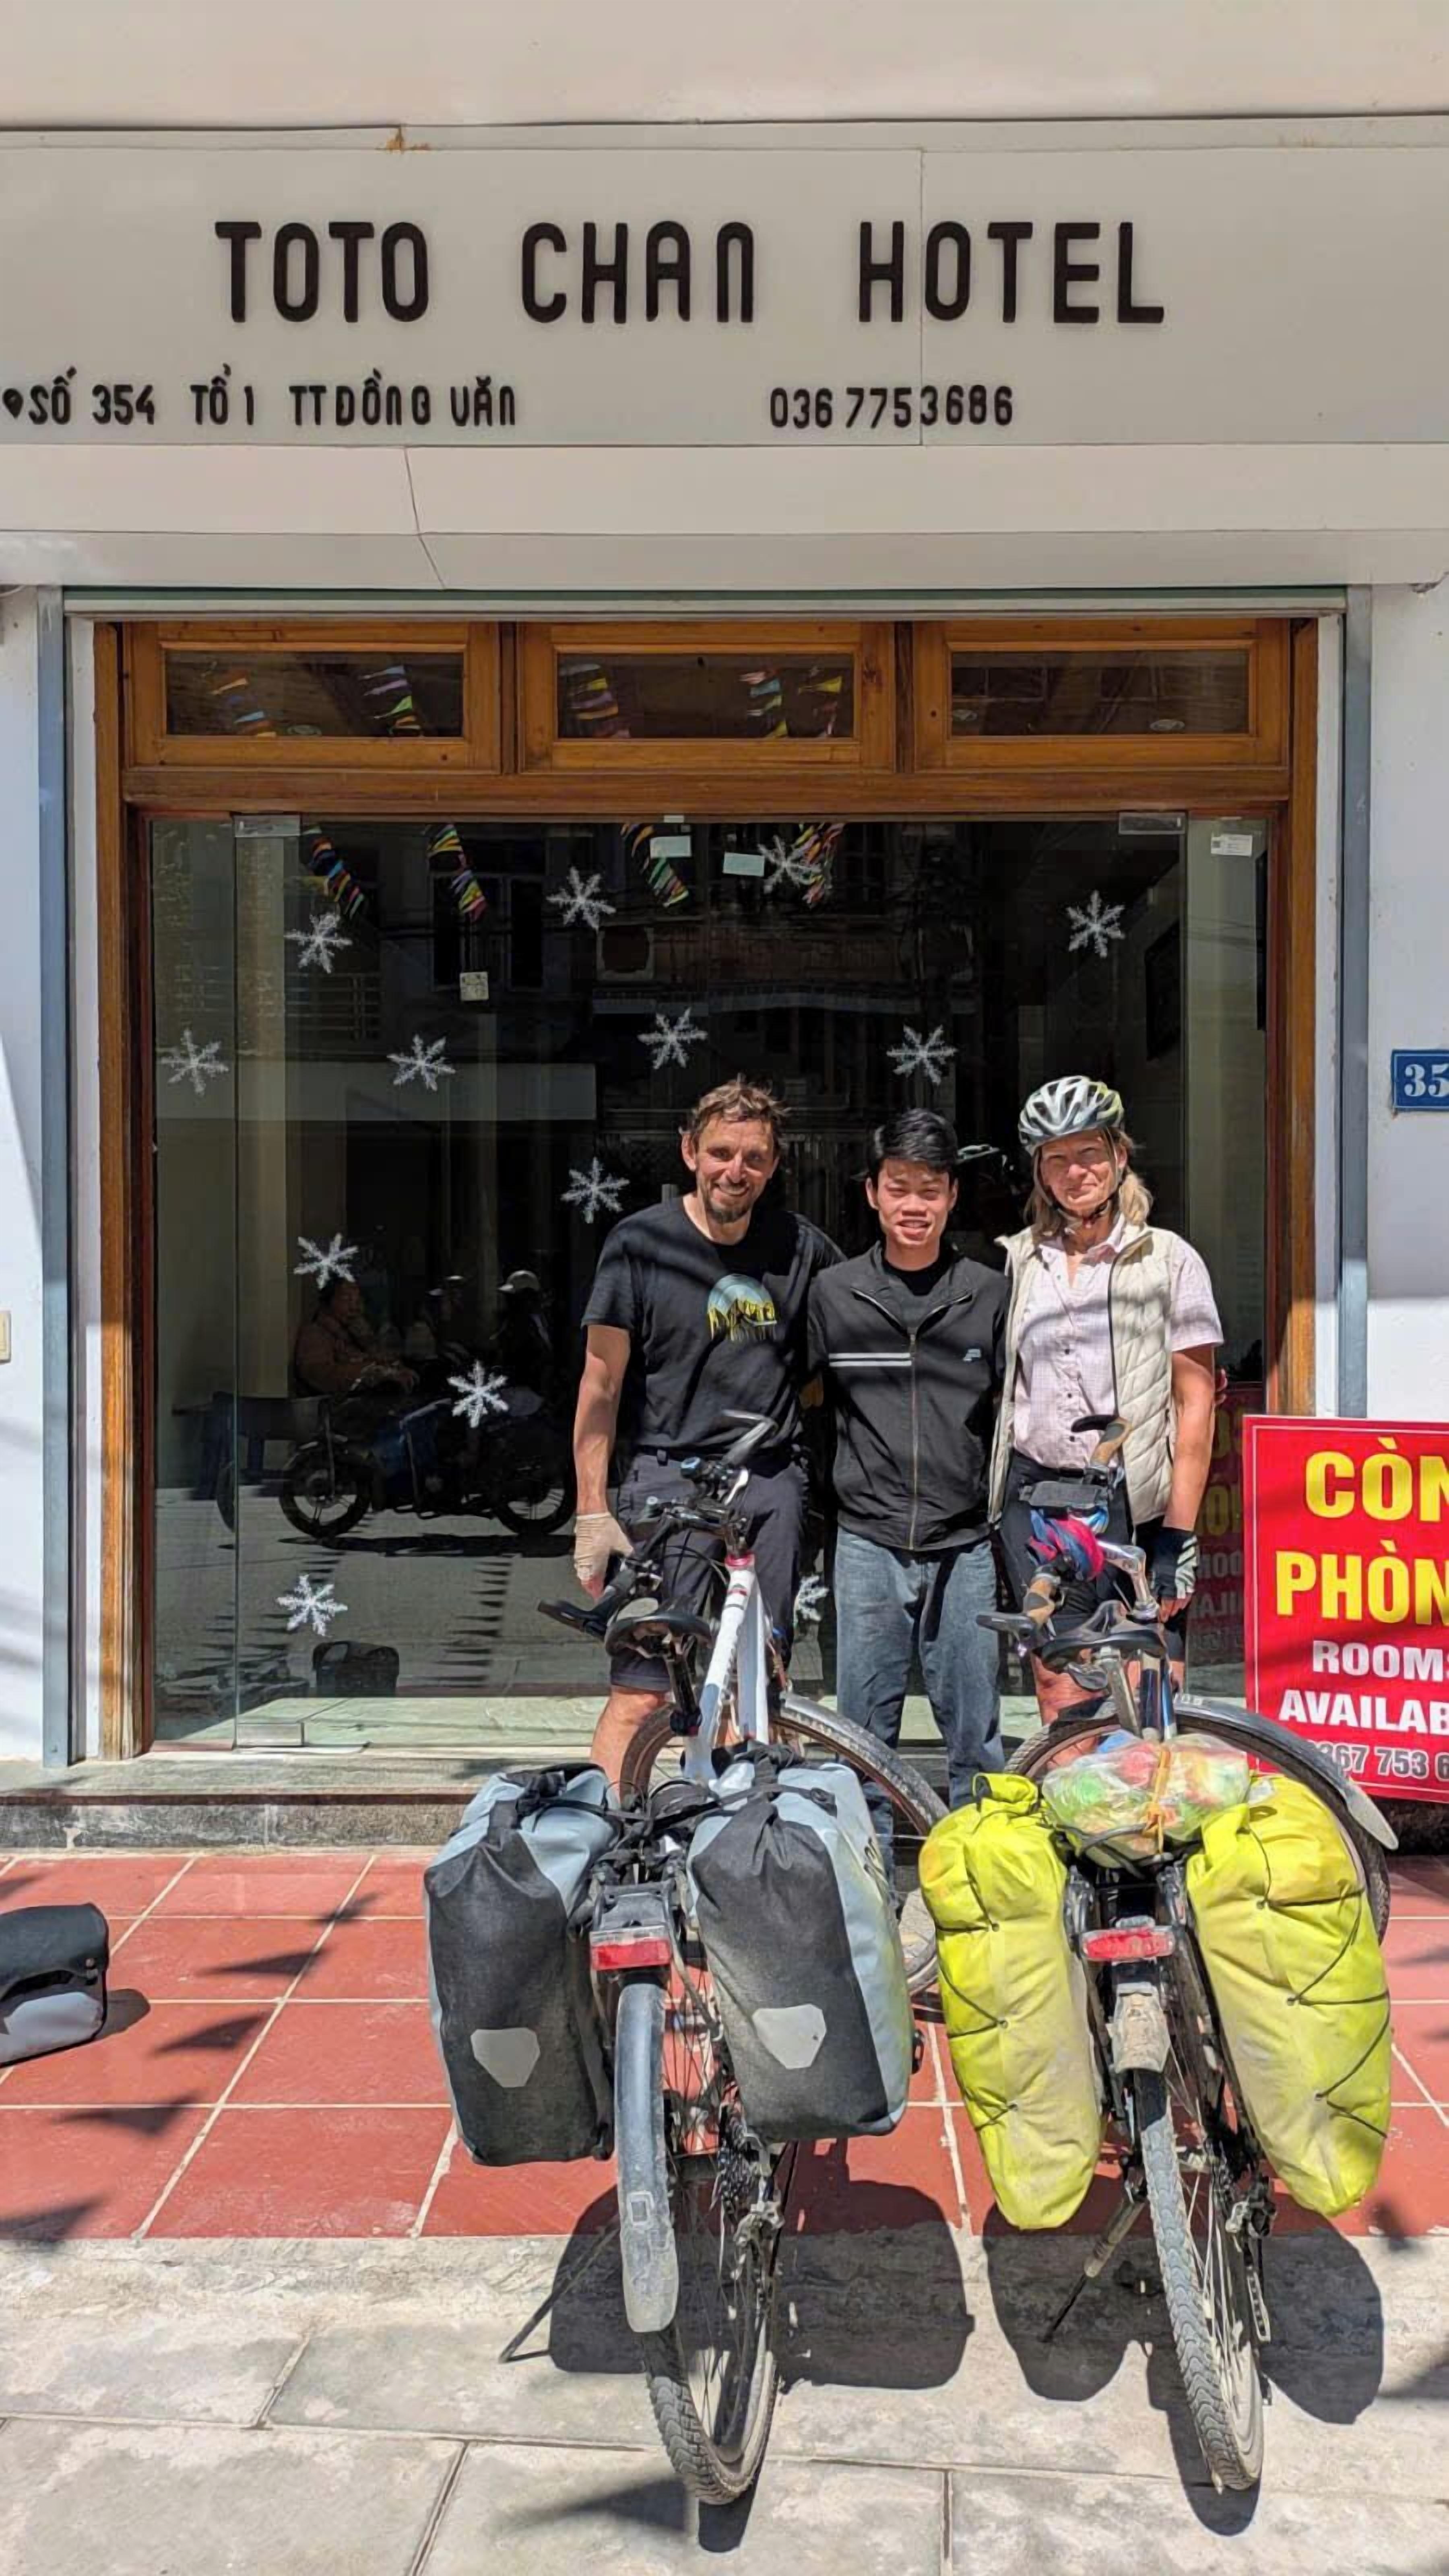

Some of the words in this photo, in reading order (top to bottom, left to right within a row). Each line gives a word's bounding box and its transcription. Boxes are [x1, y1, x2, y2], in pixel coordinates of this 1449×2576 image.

[215, 221, 429, 323] TOTO
[859, 221, 1165, 324] HOTEL
[28, 367, 76, 425] SỐ
[92, 384, 155, 425] 354
[190, 363, 231, 425] TỔ
[1404, 1063, 1449, 1097] 35
[1276, 1539, 1449, 1625] PHÒN
[1313, 1640, 1449, 1682] ROOM
[1278, 1689, 1449, 1736] AVAILAB
[1374, 1745, 1429, 1779] 753
